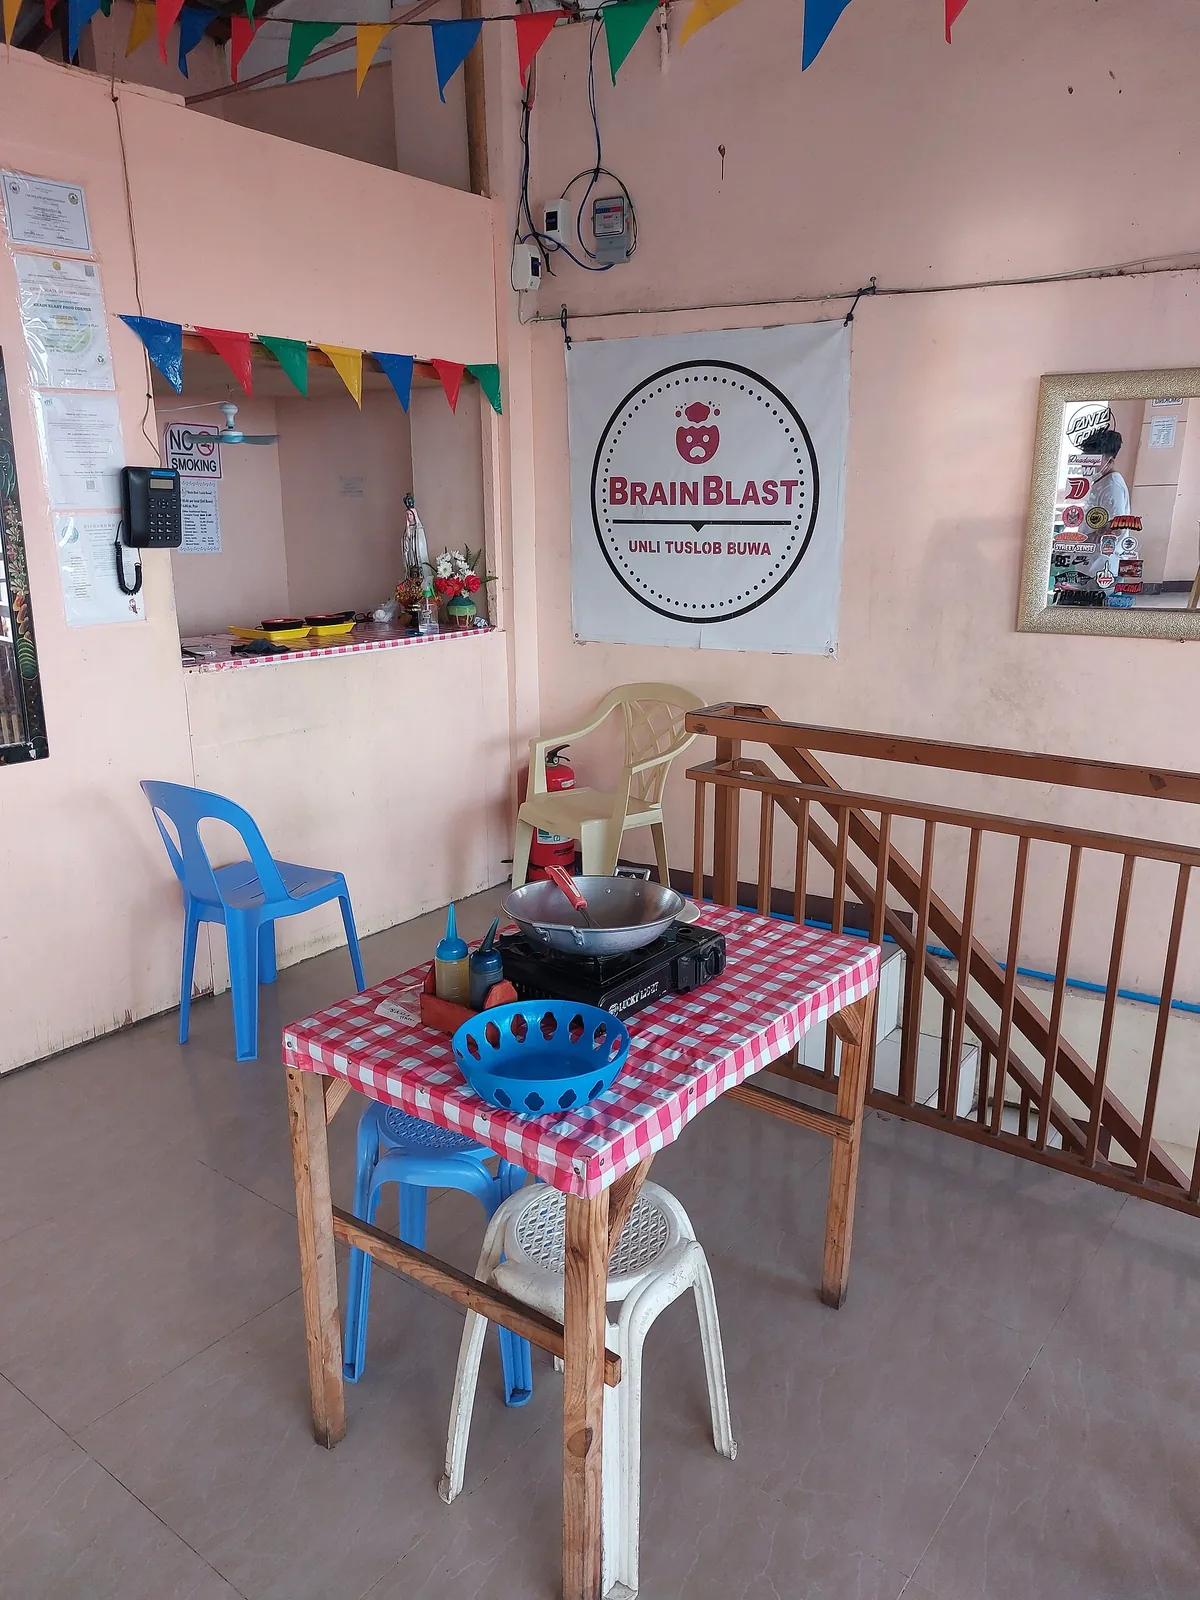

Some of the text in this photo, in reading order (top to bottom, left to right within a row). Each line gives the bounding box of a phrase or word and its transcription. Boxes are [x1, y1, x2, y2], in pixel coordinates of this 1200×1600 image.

[171, 457, 217, 473] SMOKING
[628, 540, 771, 556] UNLI TUSLOB BUWA
